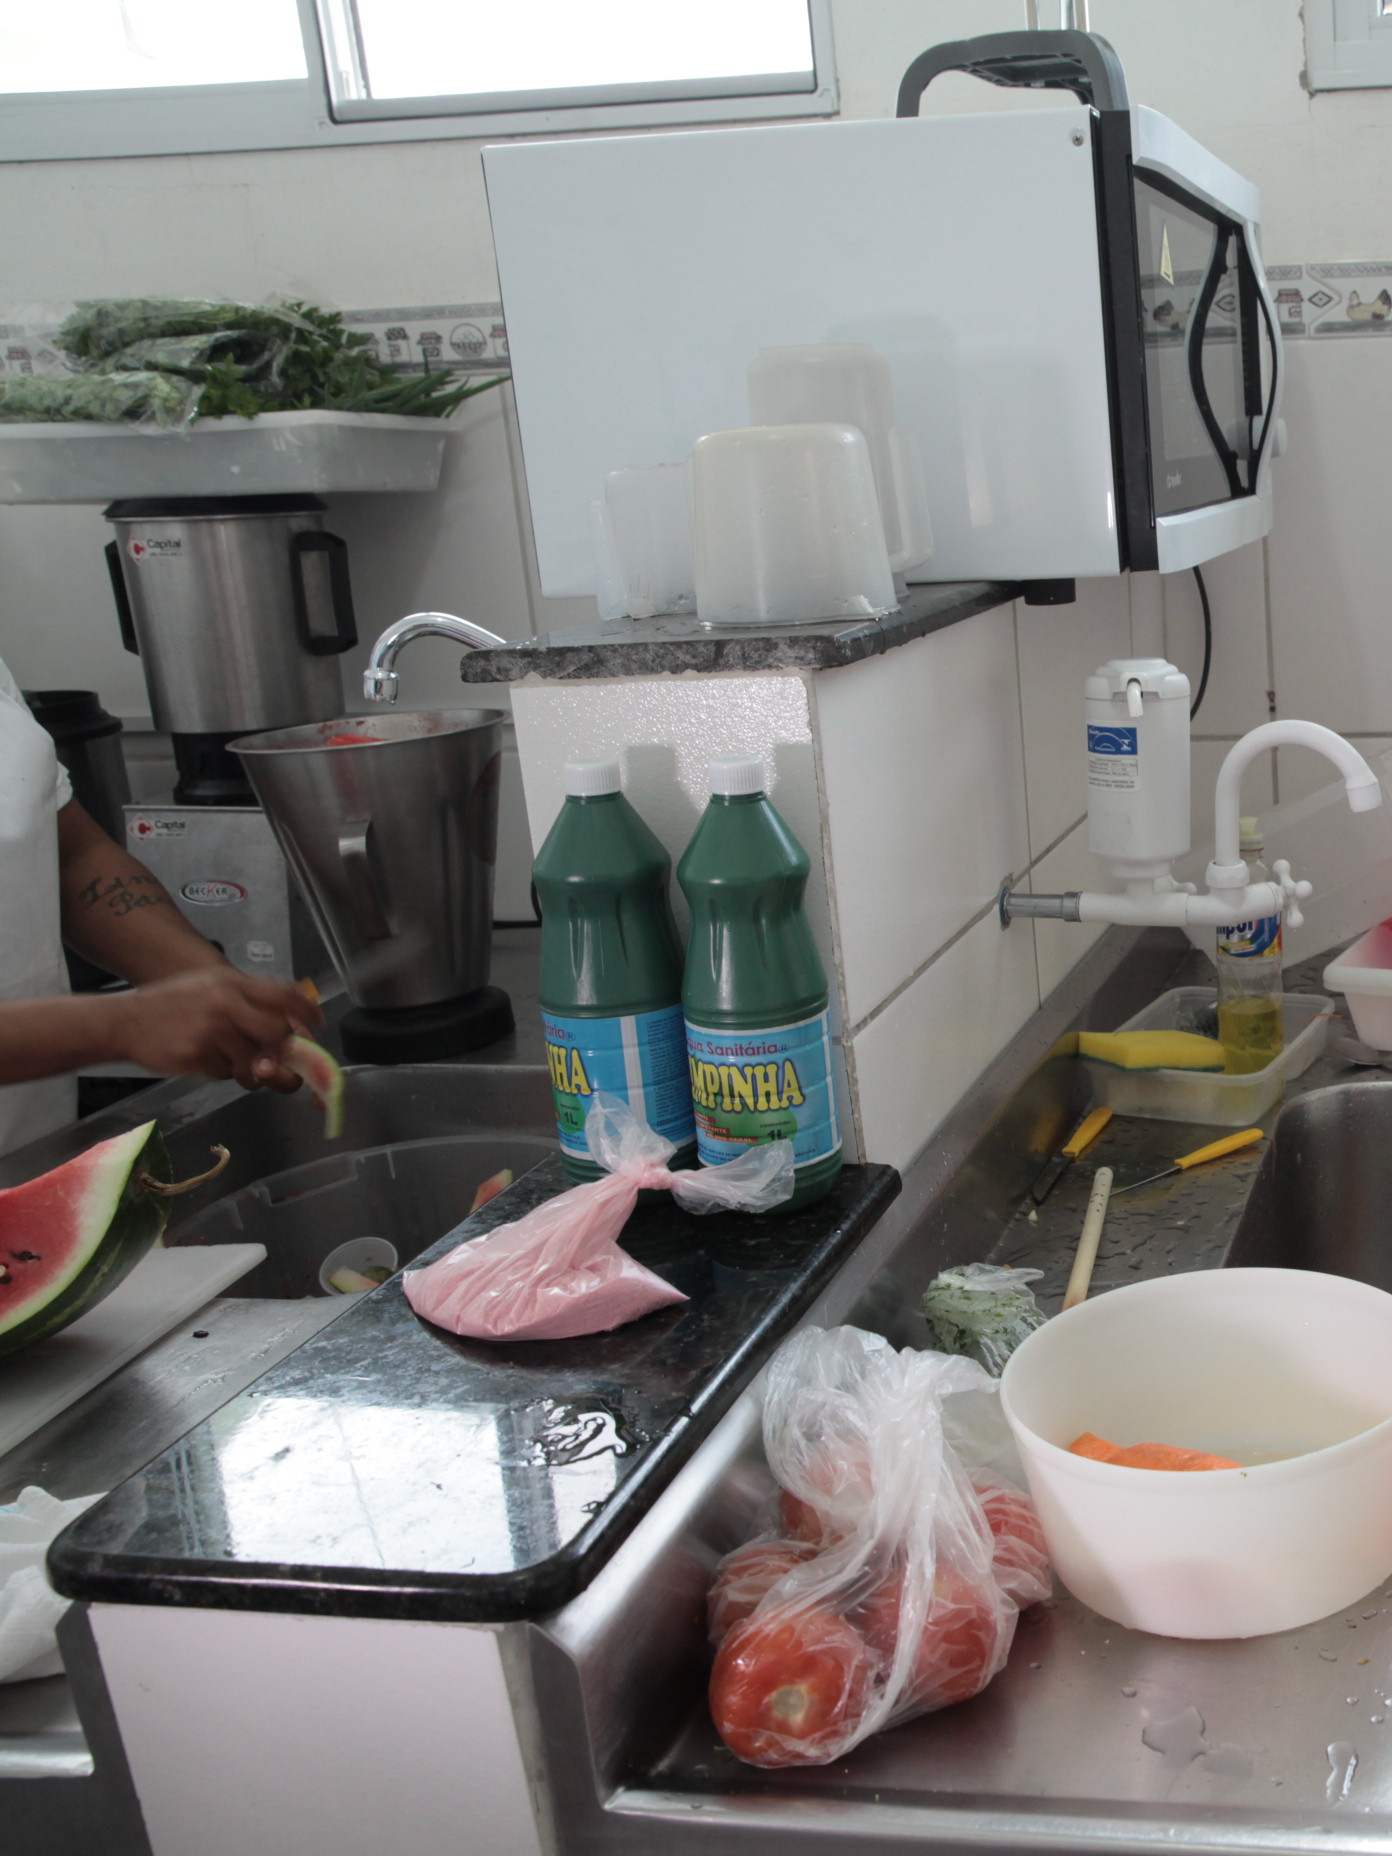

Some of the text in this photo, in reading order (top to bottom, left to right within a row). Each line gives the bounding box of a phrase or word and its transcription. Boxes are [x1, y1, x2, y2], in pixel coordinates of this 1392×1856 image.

[146, 539, 182, 551] Capital
[189, 885, 227, 898] BECKER
[563, 1111, 578, 1126] 1L
